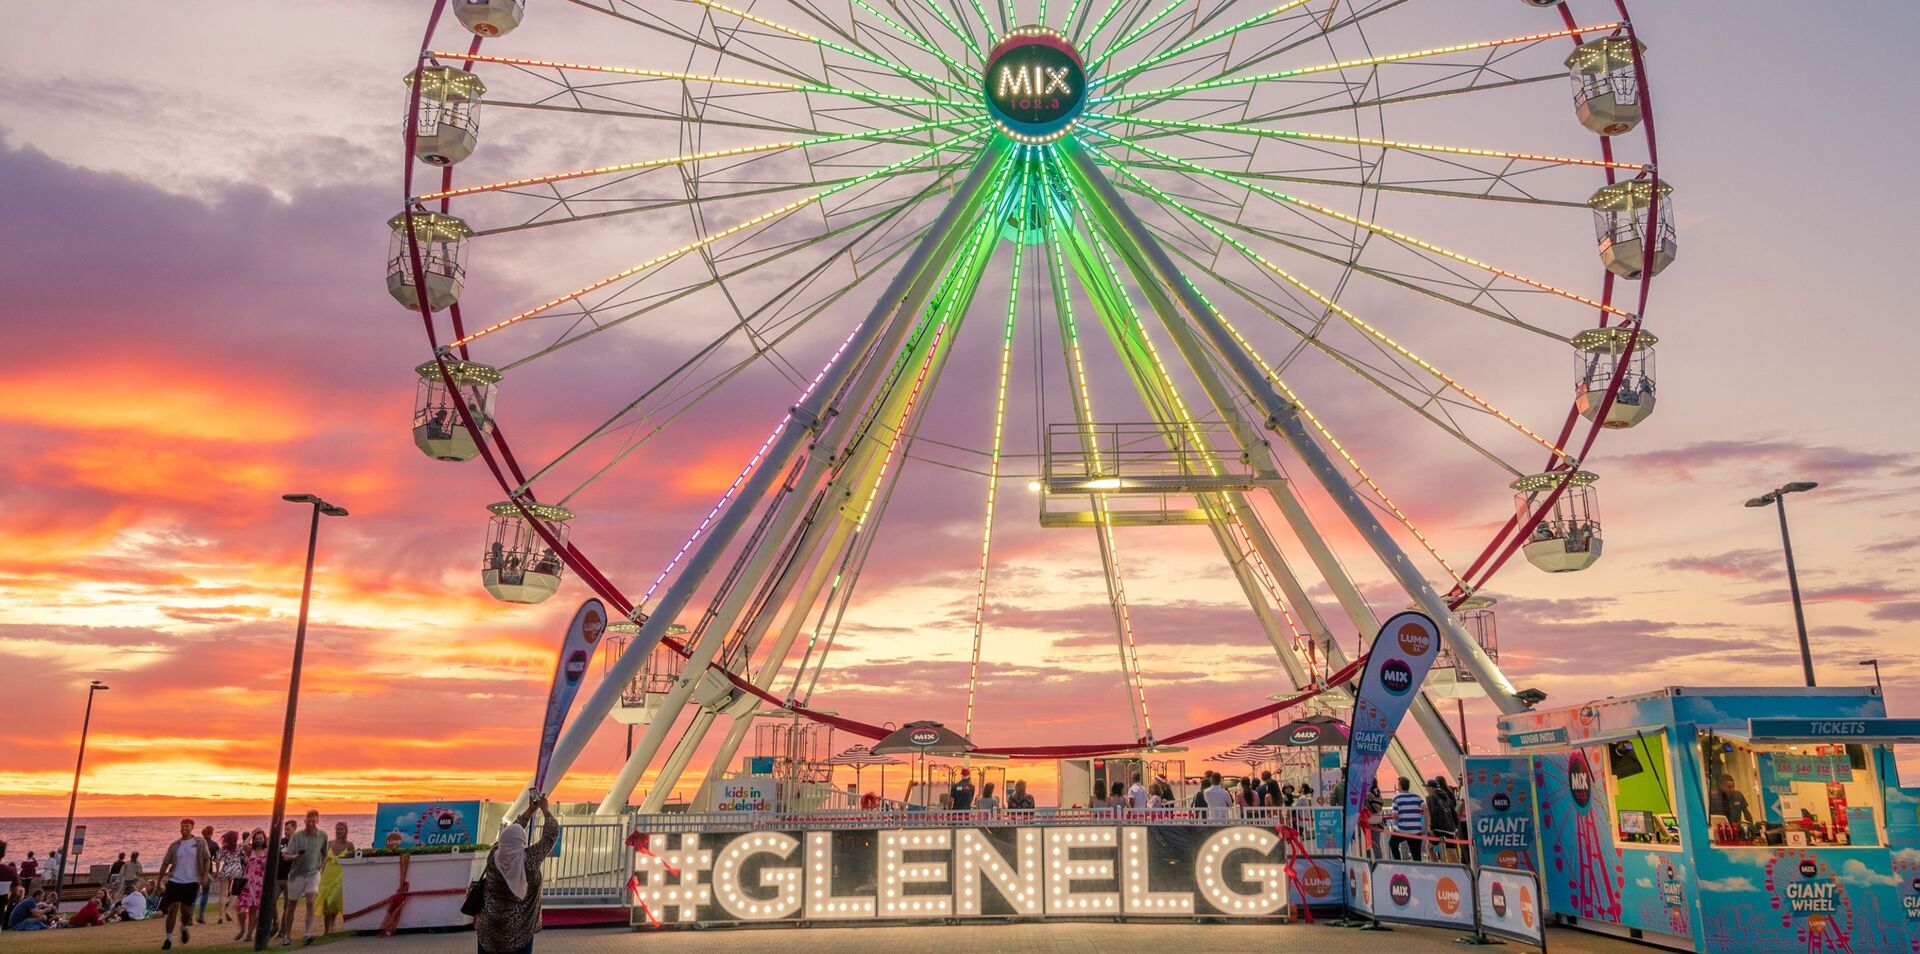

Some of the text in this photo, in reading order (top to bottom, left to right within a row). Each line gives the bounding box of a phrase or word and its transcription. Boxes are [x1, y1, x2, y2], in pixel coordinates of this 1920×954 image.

[999, 65, 1070, 96] MIX
[1011, 98, 1060, 110] 102.3
[1400, 633, 1430, 646] LUMO
[1384, 670, 1408, 683] MIX
[1810, 721, 1866, 734] TICKETS
[1294, 731, 1316, 739] MIX
[1355, 731, 1385, 744] GIANT
[1357, 742, 1383, 752] WHEEL
[1571, 773, 1589, 790] MIX
[725, 786, 761, 798] kids in
[719, 799, 772, 811] adelaide
[1320, 810, 1336, 818] EXIT
[1477, 816, 1530, 833] GIANT
[428, 833, 465, 844] GIANT
[1482, 833, 1528, 847] WHEEL
[1801, 865, 1815, 873] MIX
[1392, 885, 1408, 897] MIX
[1438, 890, 1460, 901] LUMO
[1786, 883, 1836, 898] GIANT
[1493, 894, 1505, 907] MIX
[1791, 899, 1836, 912] WHEEL
